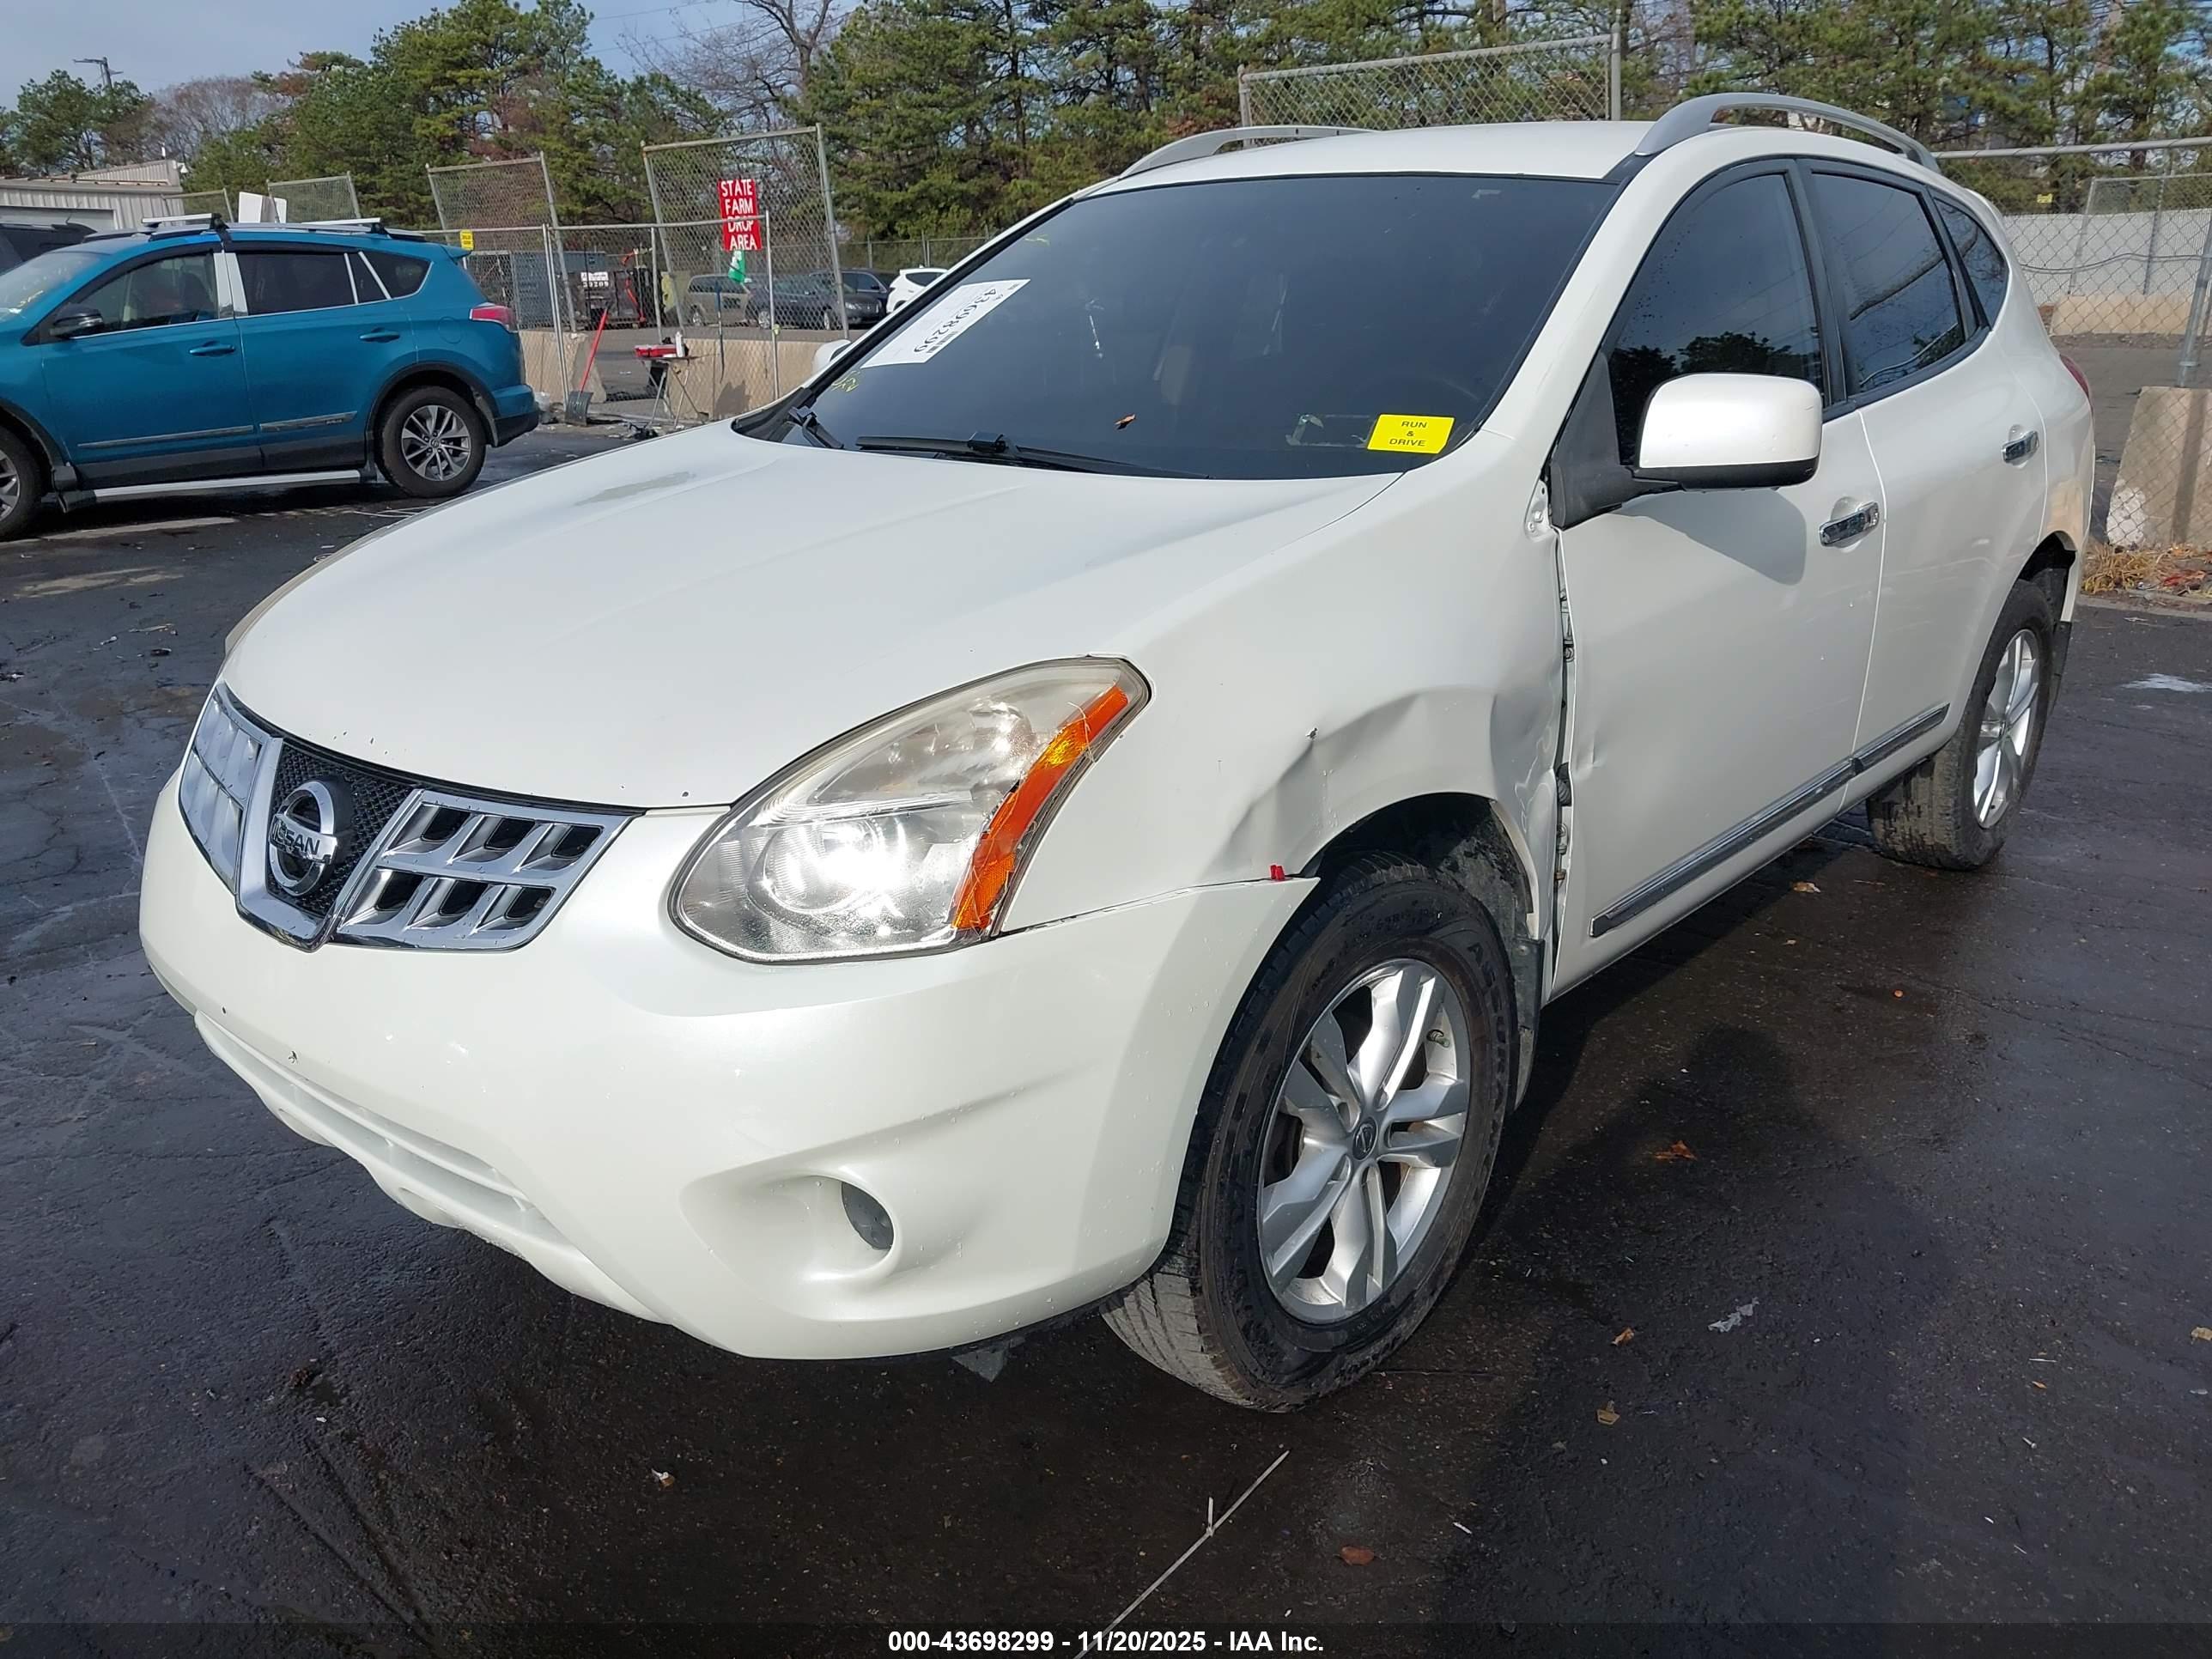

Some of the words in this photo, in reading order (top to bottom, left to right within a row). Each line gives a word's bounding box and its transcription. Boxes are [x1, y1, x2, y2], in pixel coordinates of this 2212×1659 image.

[720, 179, 753, 198] STATE
[724, 198, 754, 216] FARM
[727, 216, 755, 233] DROP
[729, 234, 758, 252] AREA
[1401, 420, 1428, 428] RUN
[1389, 438, 1427, 447] DRIVE
